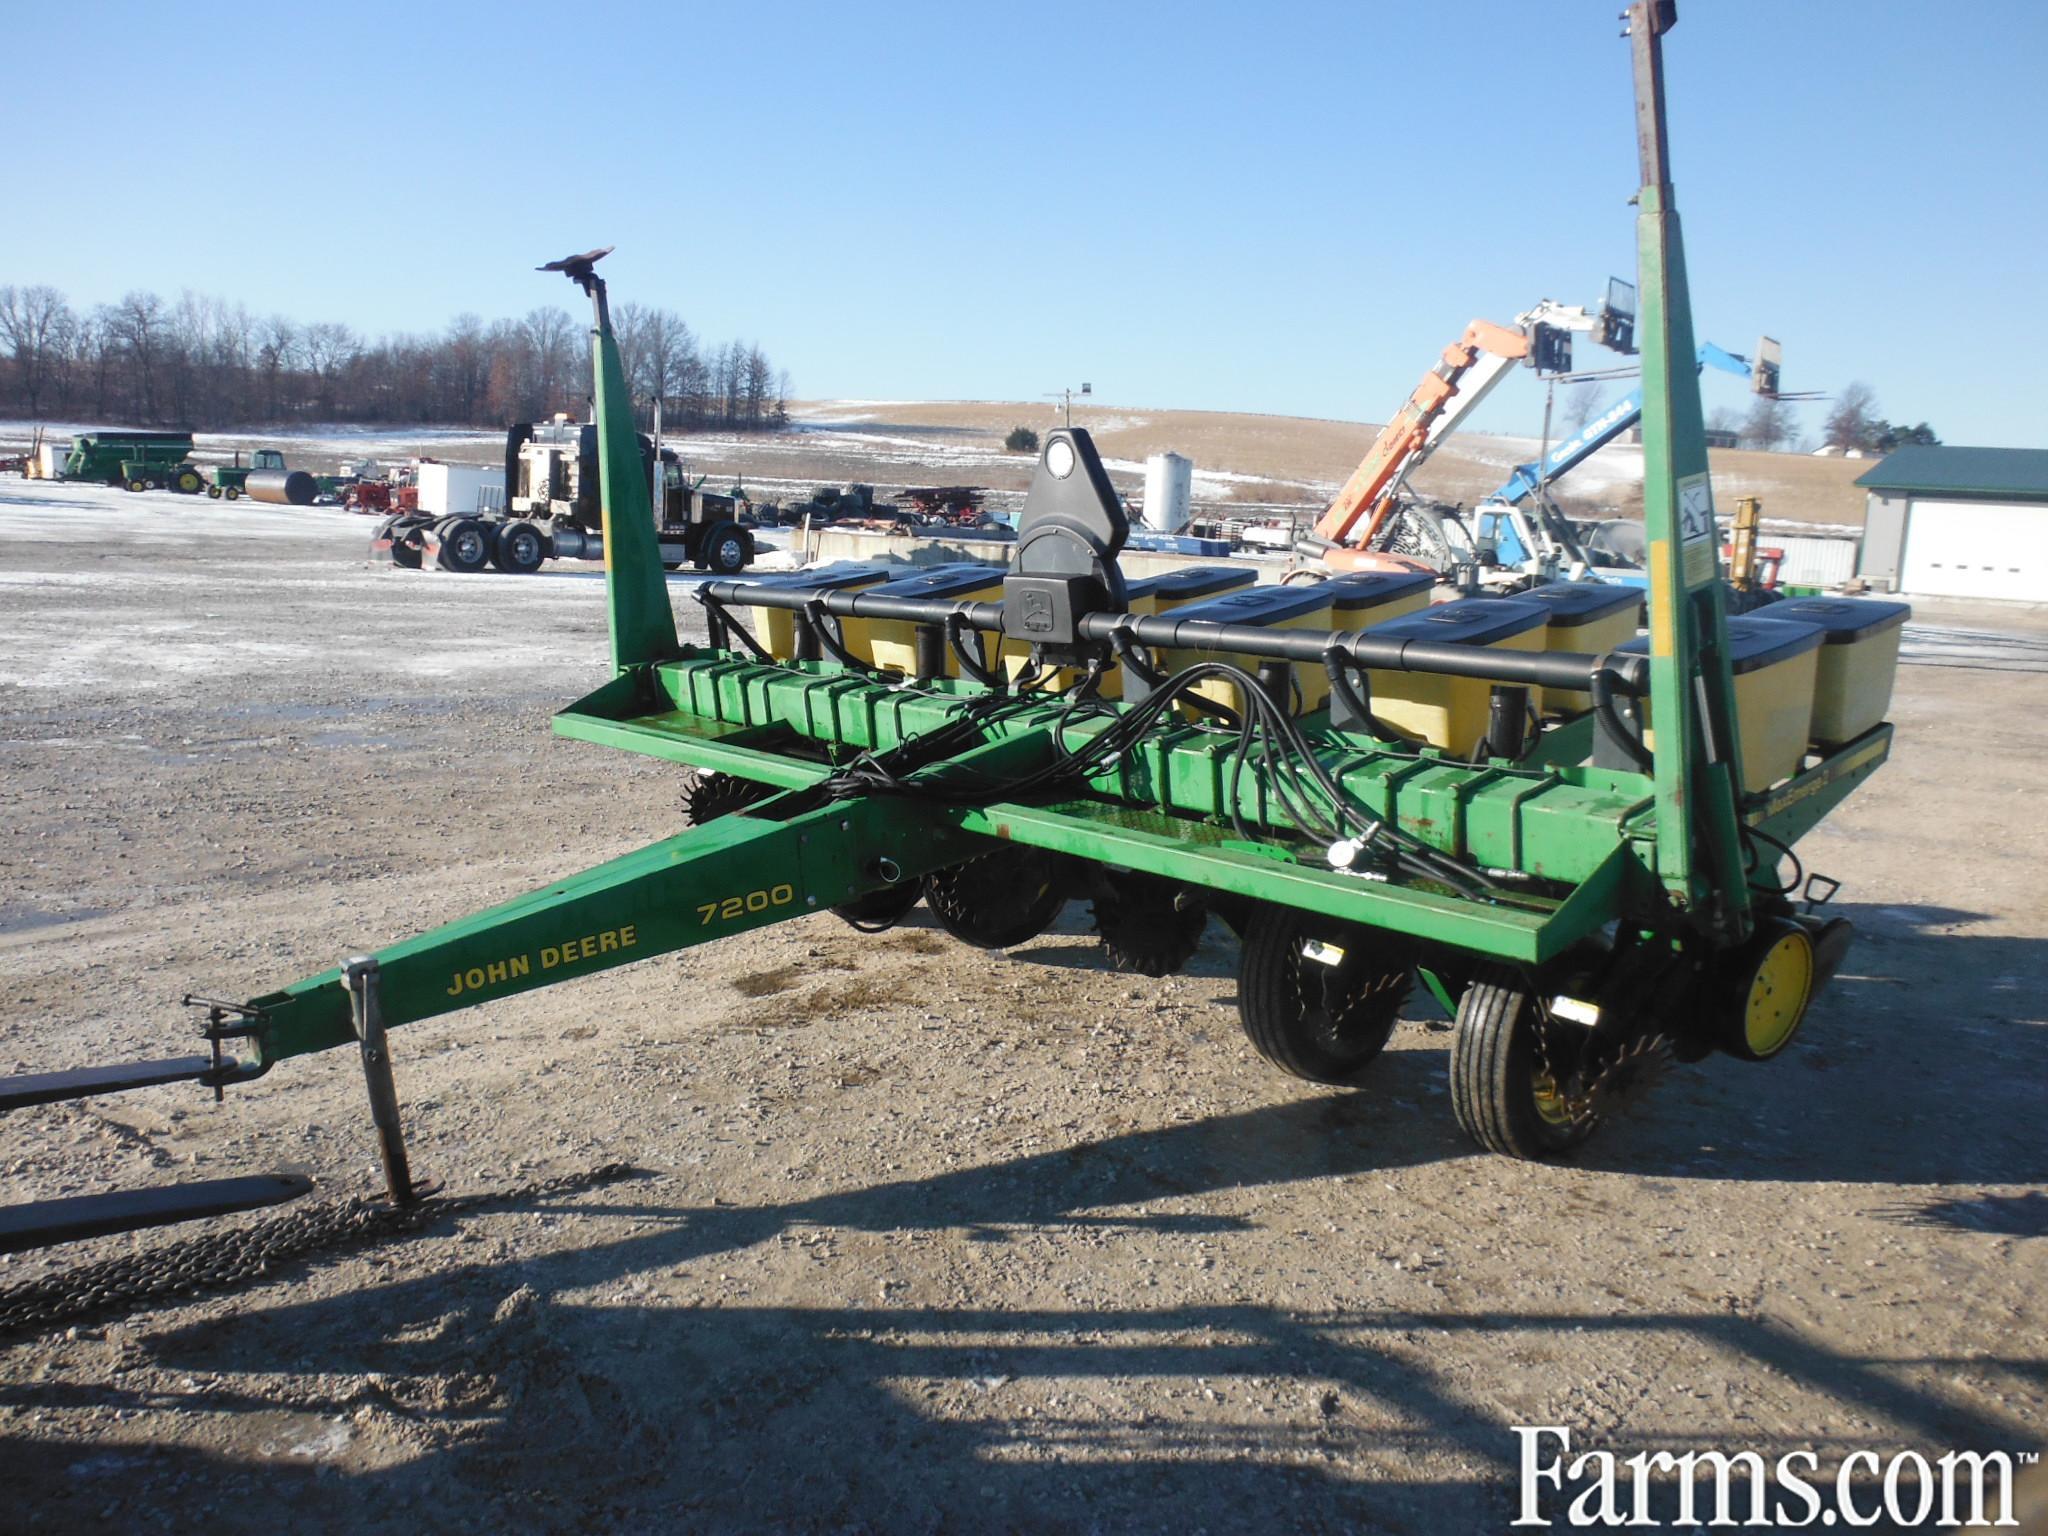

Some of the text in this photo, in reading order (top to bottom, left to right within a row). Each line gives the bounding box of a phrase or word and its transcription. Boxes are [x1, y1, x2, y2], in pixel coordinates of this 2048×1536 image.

[696, 884, 793, 926] 7200
[447, 924, 638, 997] JOHN DEERE
